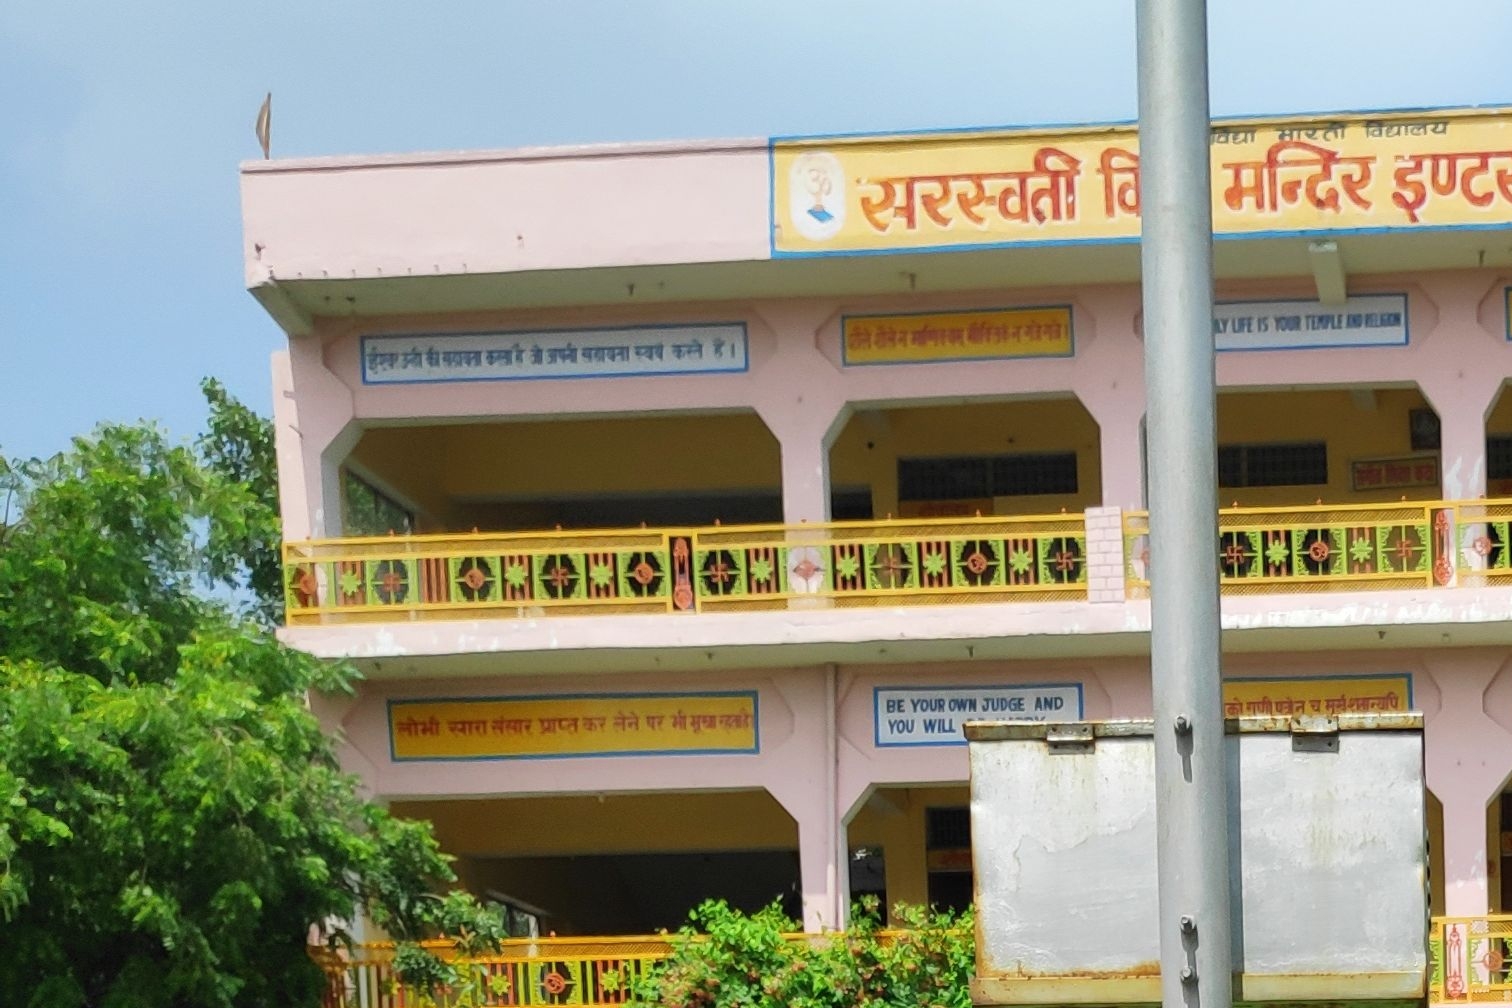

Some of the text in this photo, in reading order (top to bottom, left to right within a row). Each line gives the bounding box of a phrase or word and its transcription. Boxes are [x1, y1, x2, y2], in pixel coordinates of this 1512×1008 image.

[858, 147, 1081, 233] सरस्वती
[1098, 147, 1141, 219] वि
[1222, 141, 1376, 214] मन्दिर
[887, 696, 1064, 713] BE YOUR OWN JUDGE AND
[889, 719, 915, 734] YOU
[924, 718, 956, 733] WILL
